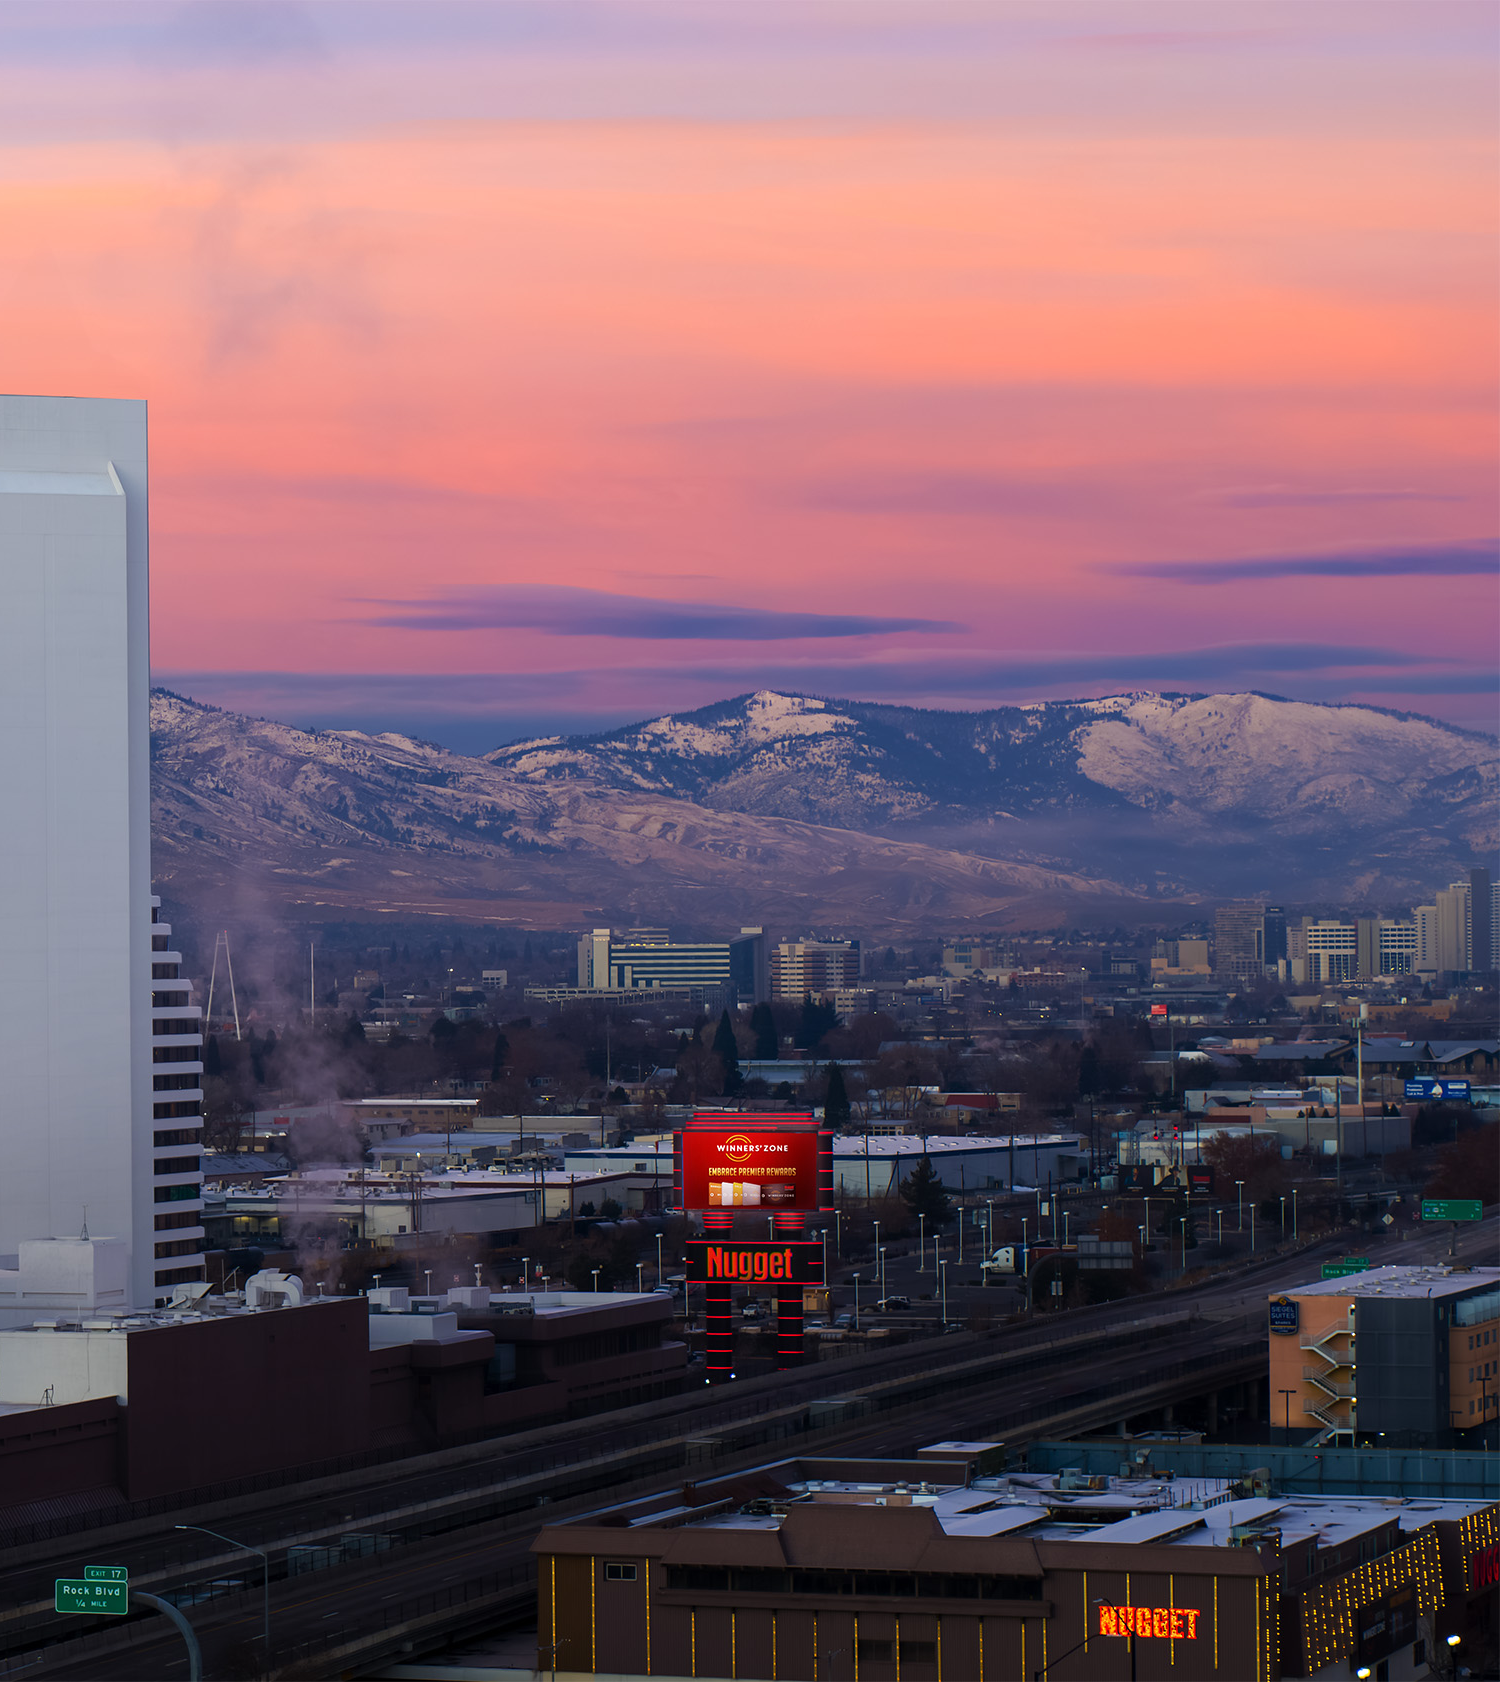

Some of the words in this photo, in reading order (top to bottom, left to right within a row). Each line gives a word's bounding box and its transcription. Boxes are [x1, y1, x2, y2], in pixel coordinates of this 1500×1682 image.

[708, 1167, 737, 1177] EMBRACE
[738, 1167, 765, 1177] PREMIER
[766, 1167, 797, 1177] REWARDS
[707, 1247, 793, 1281] Nugget
[111, 1570, 121, 1578] 17
[63, 1585, 90, 1595] Rock
[95, 1586, 120, 1596] Blvd
[1099, 1606, 1200, 1639] NUGGET
